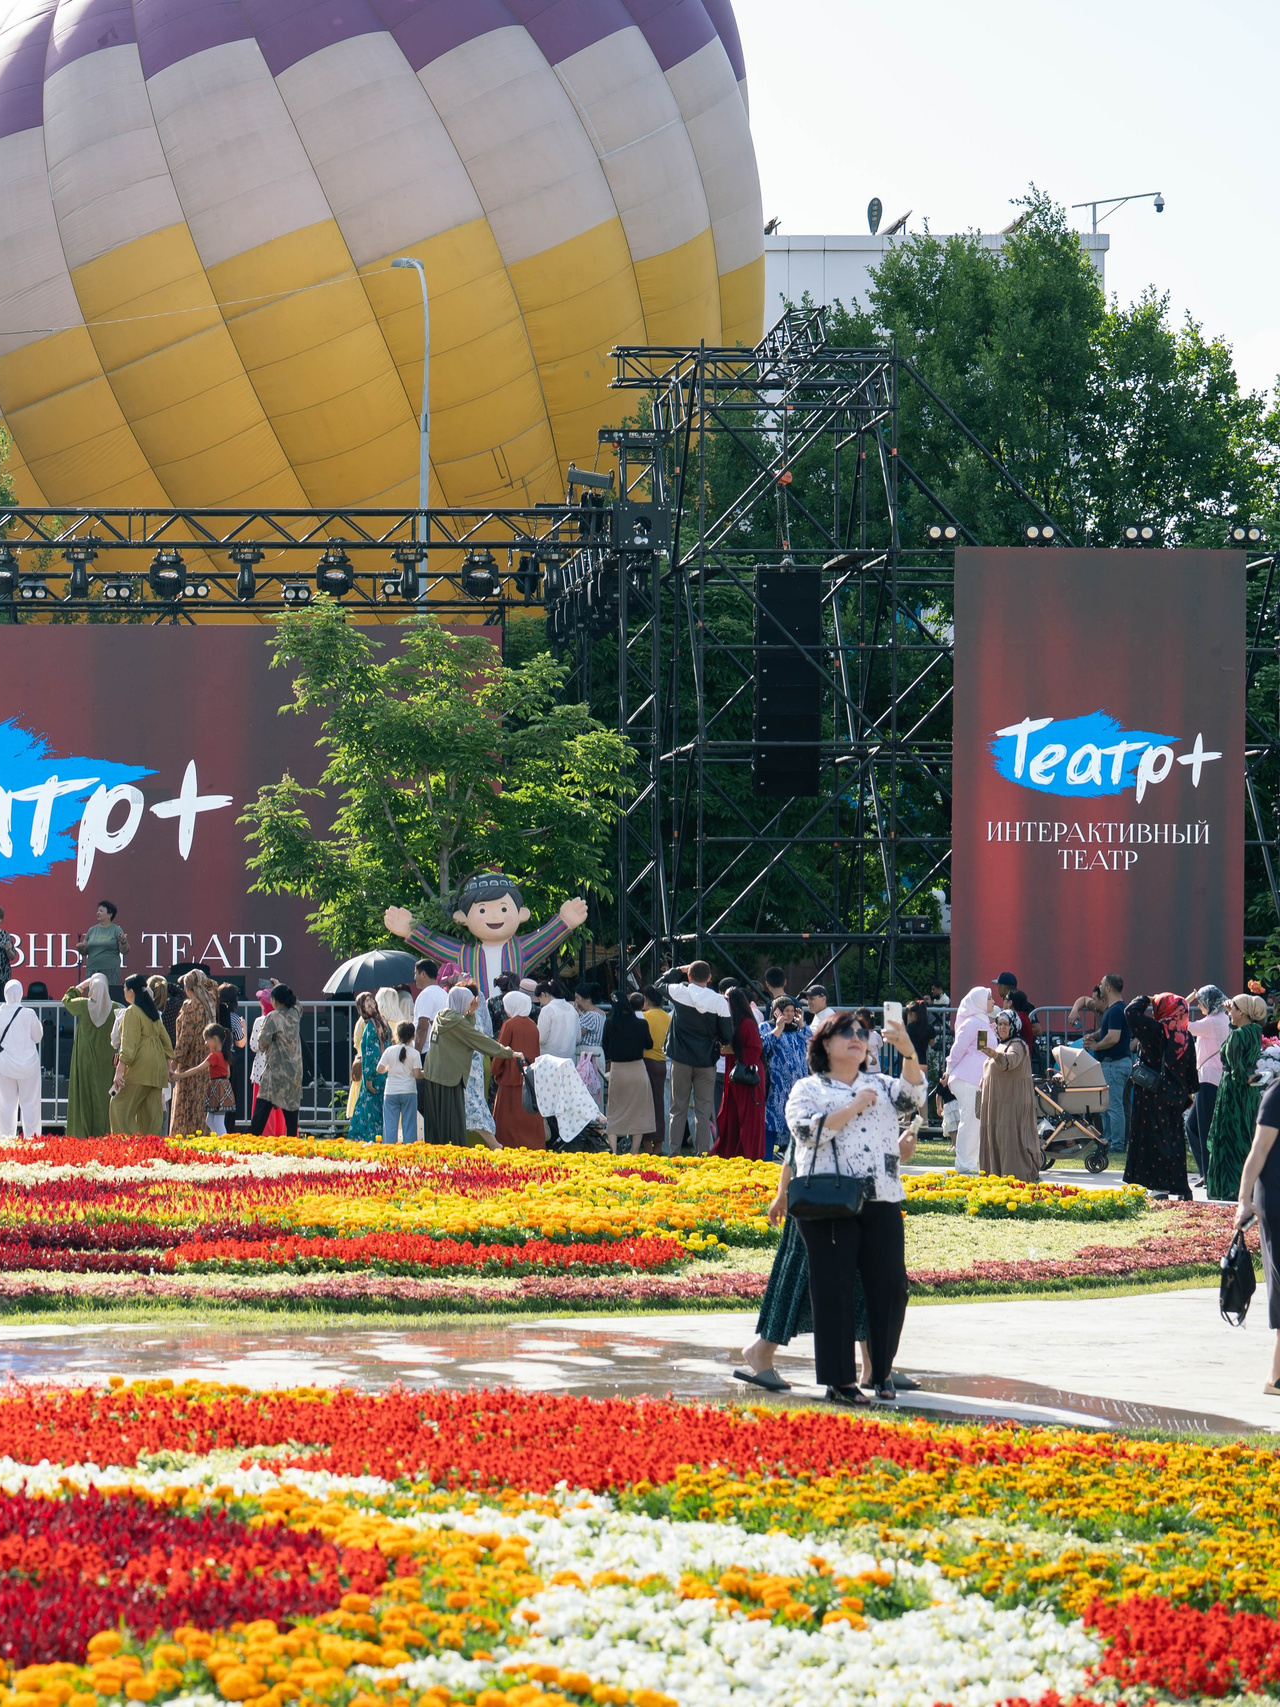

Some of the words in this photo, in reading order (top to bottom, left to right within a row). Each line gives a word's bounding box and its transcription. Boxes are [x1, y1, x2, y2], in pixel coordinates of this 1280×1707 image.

[995, 717, 1223, 804] Театр+
[987, 820, 1210, 845] ИНТЕРАКТИВНЫЙ
[1057, 850, 1139, 871] ТЕАТР
[141, 931, 283, 969] ТЕАТР
